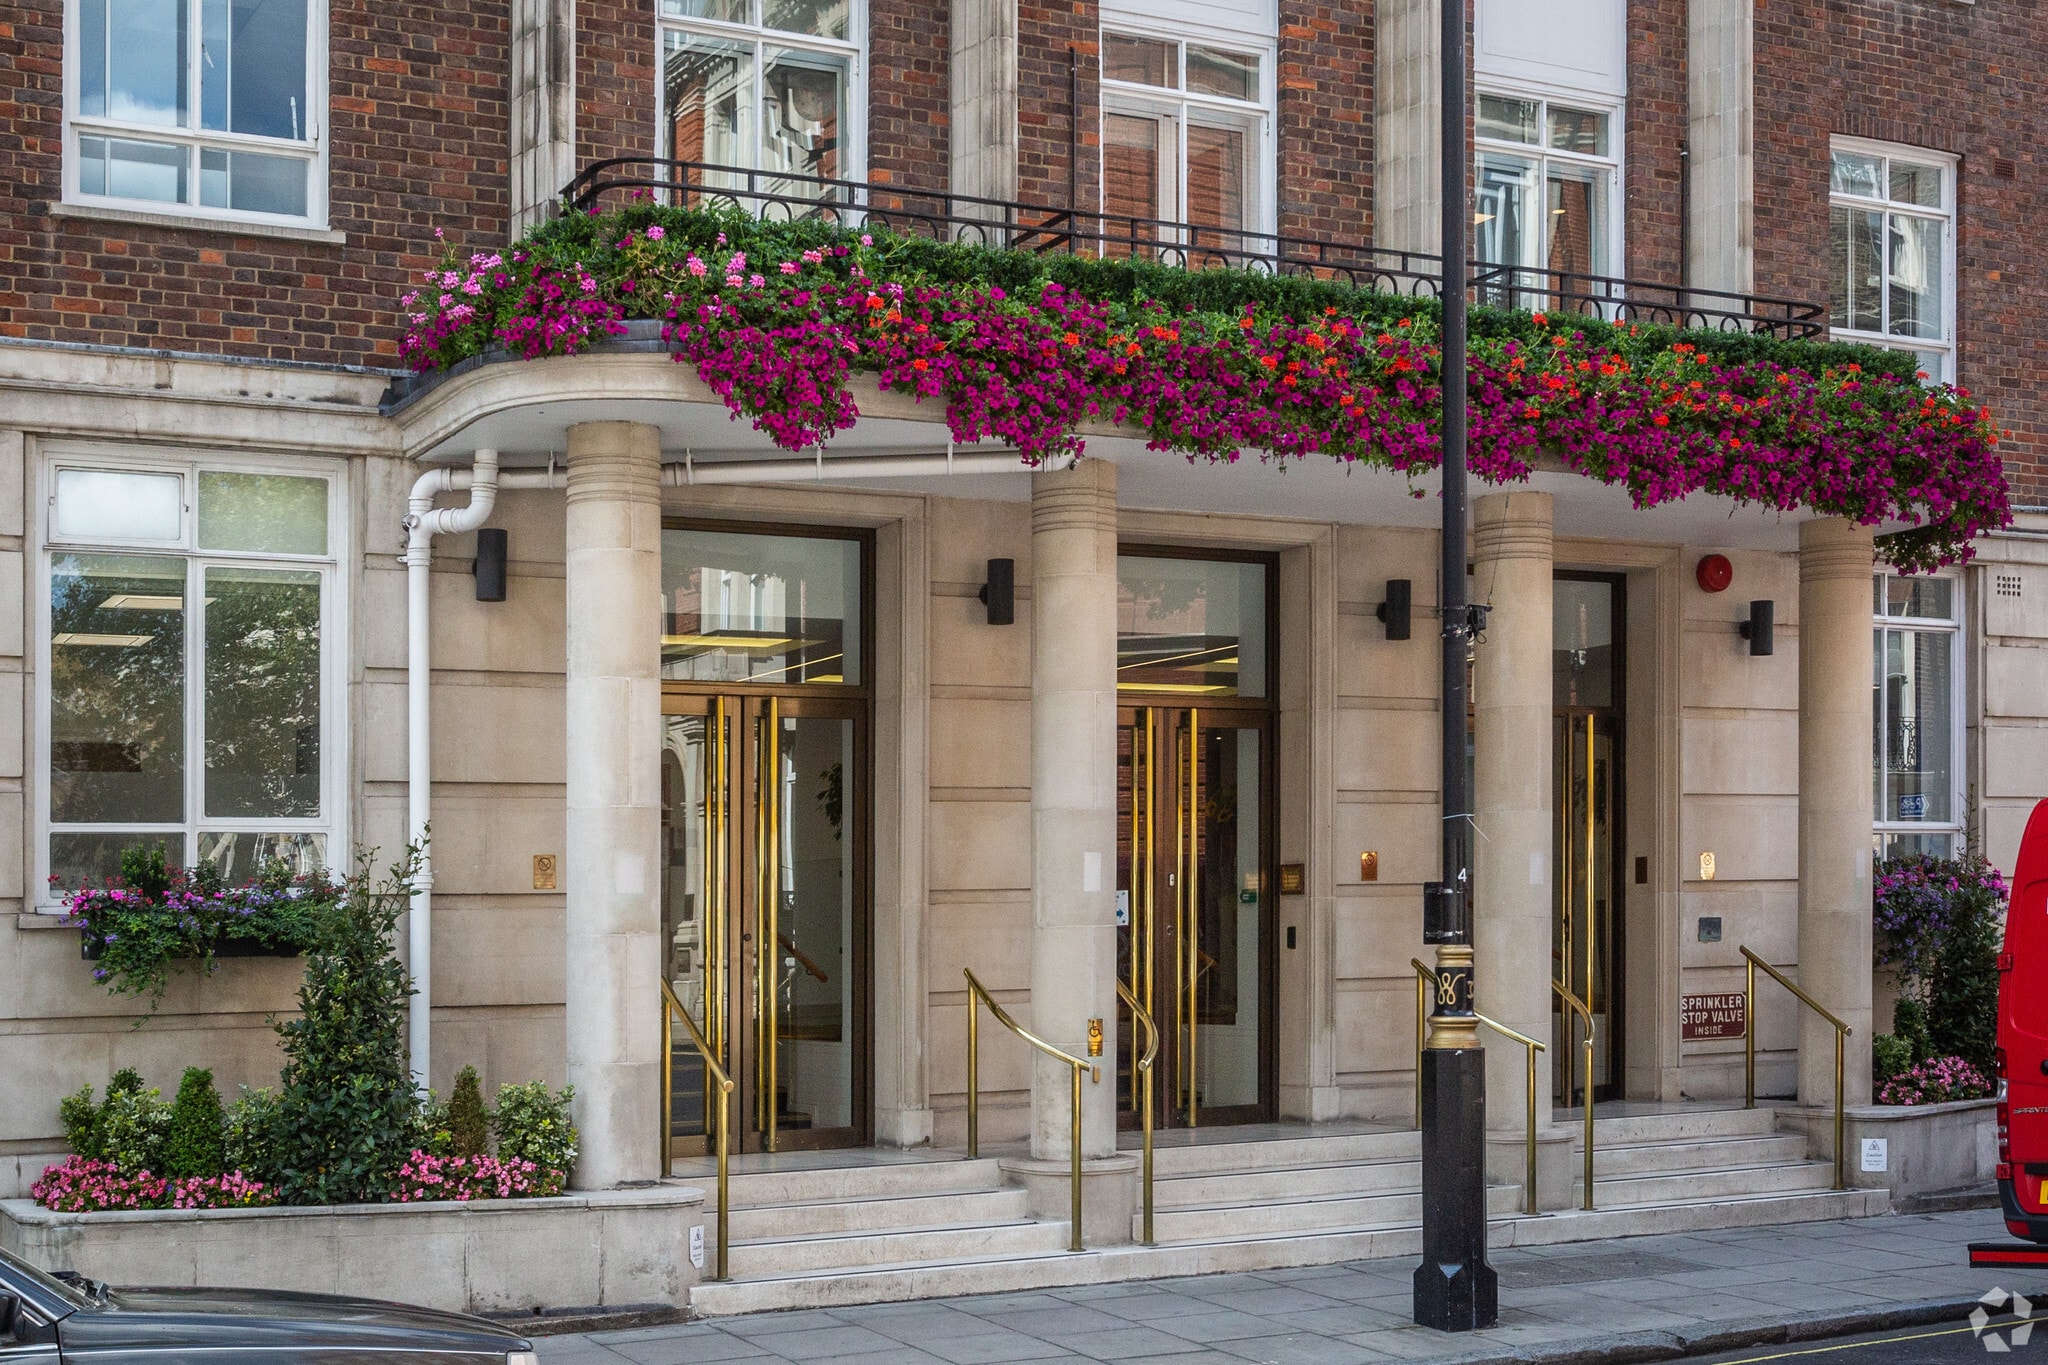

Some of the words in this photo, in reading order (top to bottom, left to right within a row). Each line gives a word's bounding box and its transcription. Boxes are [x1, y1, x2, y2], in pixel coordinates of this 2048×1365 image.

[1457, 867, 1467, 882] 4
[1682, 996, 1743, 1010] SPRINKLER
[1682, 1011, 1708, 1024] STOP
[1711, 1010, 1743, 1024] VALVE
[1694, 1025, 1723, 1035] INSIDE
